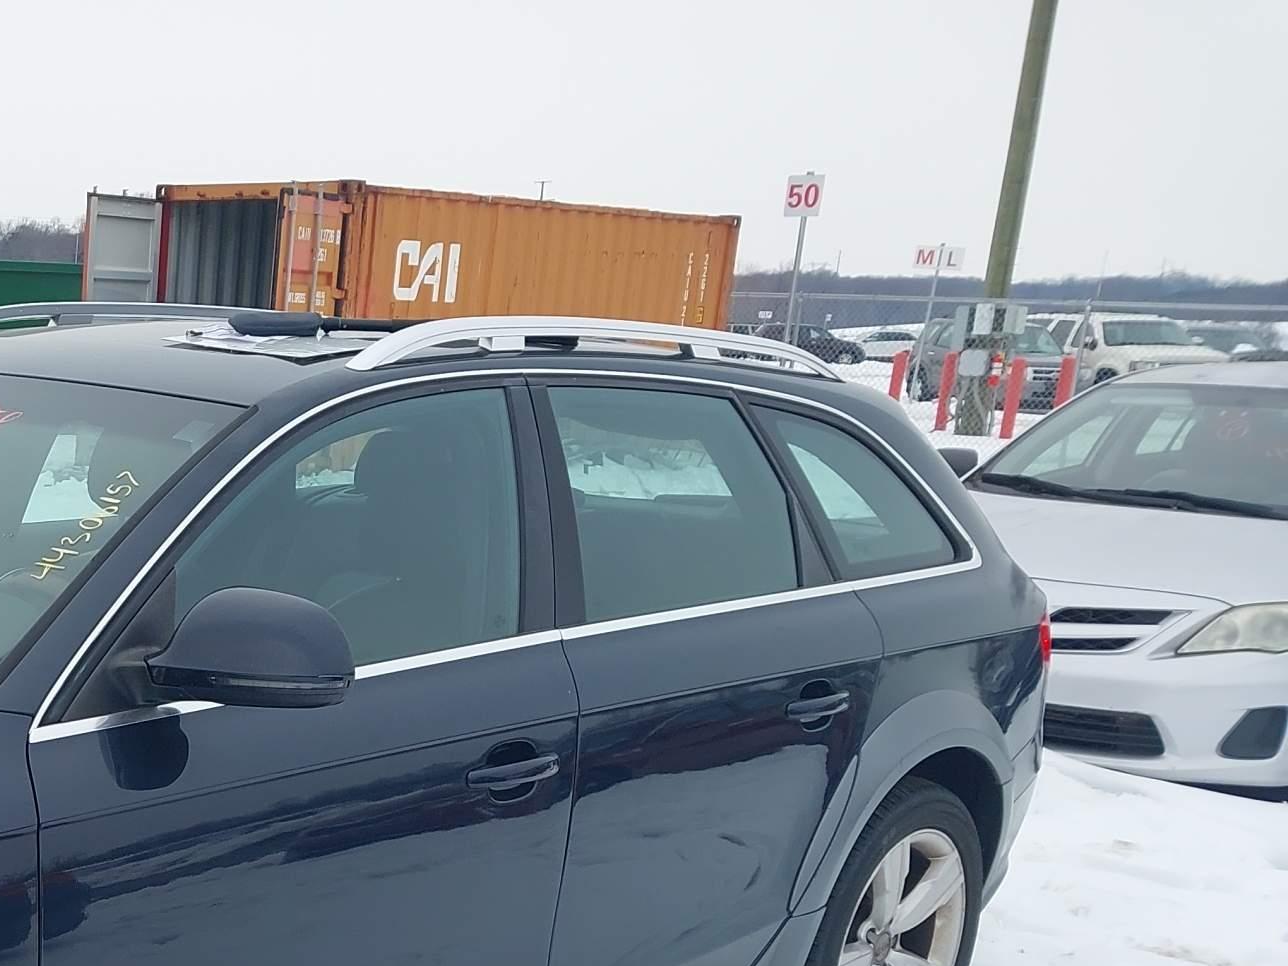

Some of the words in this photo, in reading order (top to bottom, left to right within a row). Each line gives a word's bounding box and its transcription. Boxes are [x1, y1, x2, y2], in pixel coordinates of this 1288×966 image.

[787, 183, 819, 208] 50
[393, 239, 462, 304] CAI
[916, 248, 936, 265] M
[946, 251, 958, 267] L
[30, 470, 140, 580] 44306157
